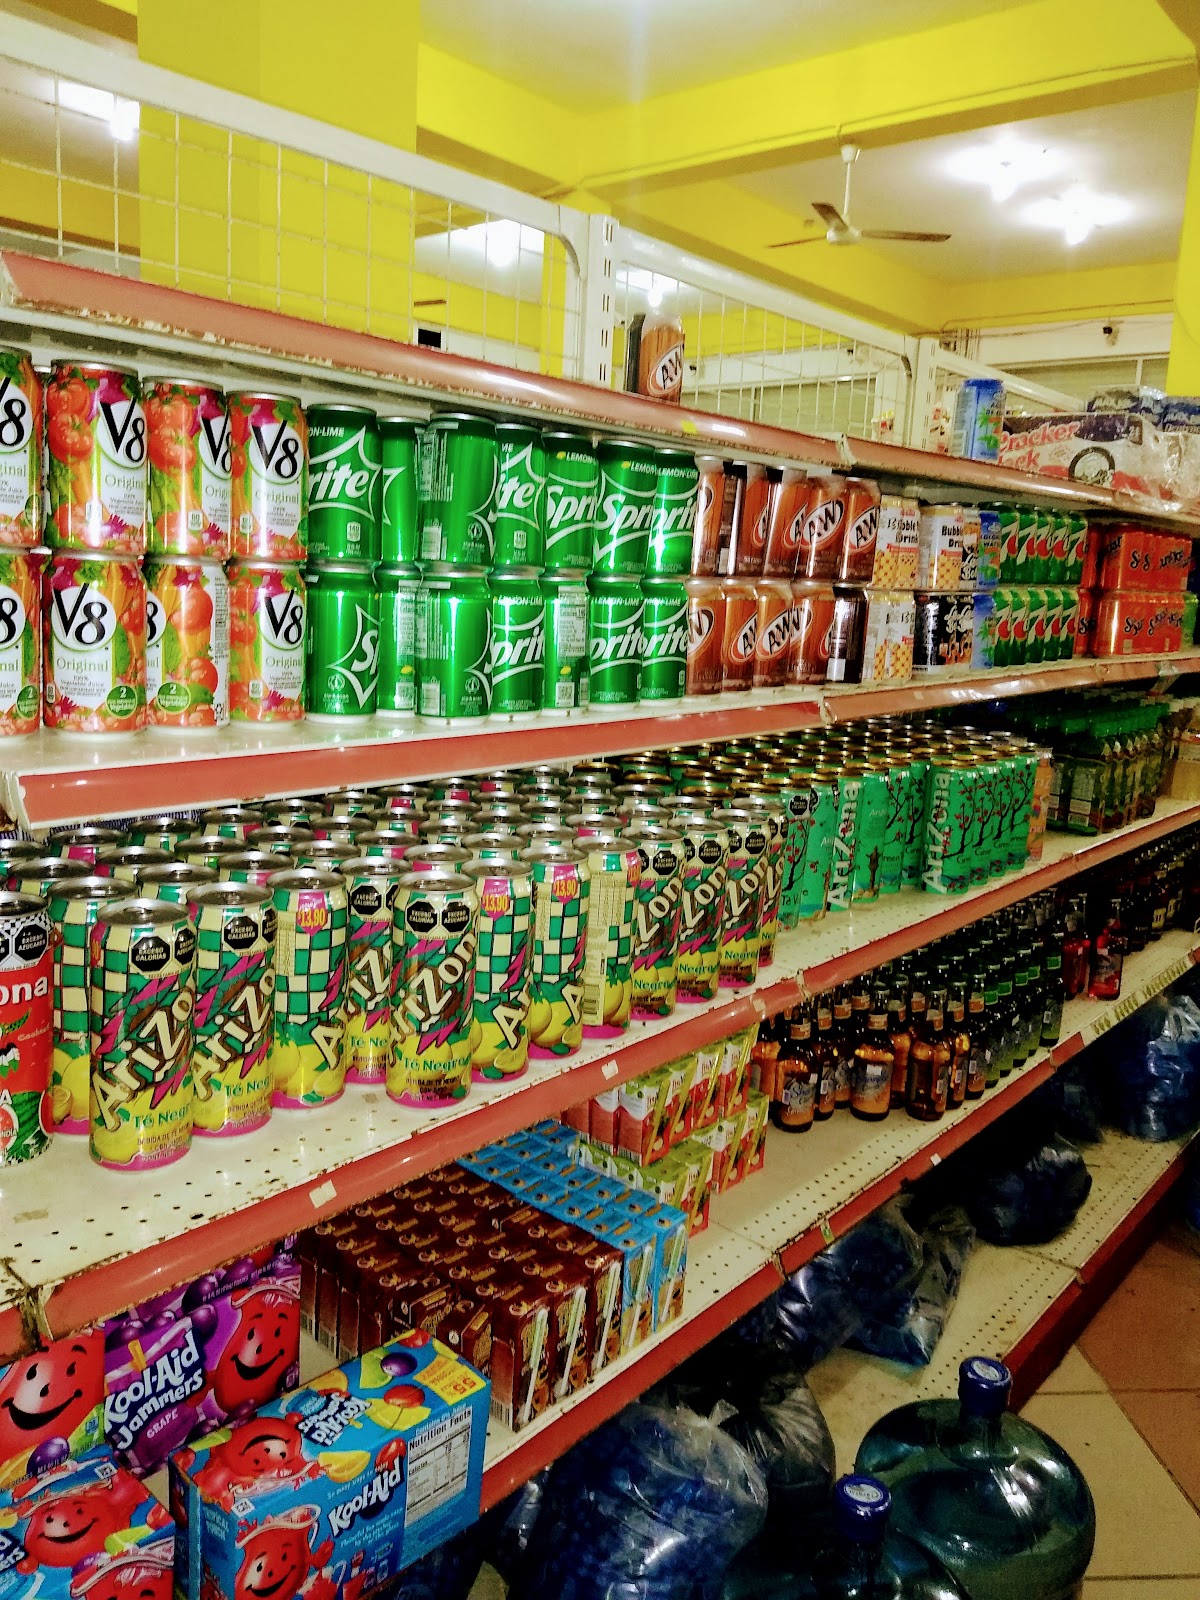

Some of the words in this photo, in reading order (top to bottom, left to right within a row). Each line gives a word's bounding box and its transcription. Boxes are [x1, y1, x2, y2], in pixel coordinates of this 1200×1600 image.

[100, 397, 145, 463] V8
[251, 420, 299, 479] V8
[53, 583, 108, 645] V8
[264, 590, 303, 645] V8
[56, 658, 109, 674] Original
[370, 1036, 387, 1048] Ne
[404, 1057, 420, 1069] Té
[225, 1081, 243, 1098] Té
[134, 1111, 153, 1129] Té
[105, 1328, 201, 1433] Kool-Aid
[116, 1369, 204, 1450] Jammers
[146, 1408, 180, 1440] GRAPE
[311, 1396, 373, 1447] Kool-Aid
[409, 1424, 447, 1451] Nutrition
[450, 1409, 471, 1428] Facts
[328, 1455, 401, 1537] Kool-Aid
